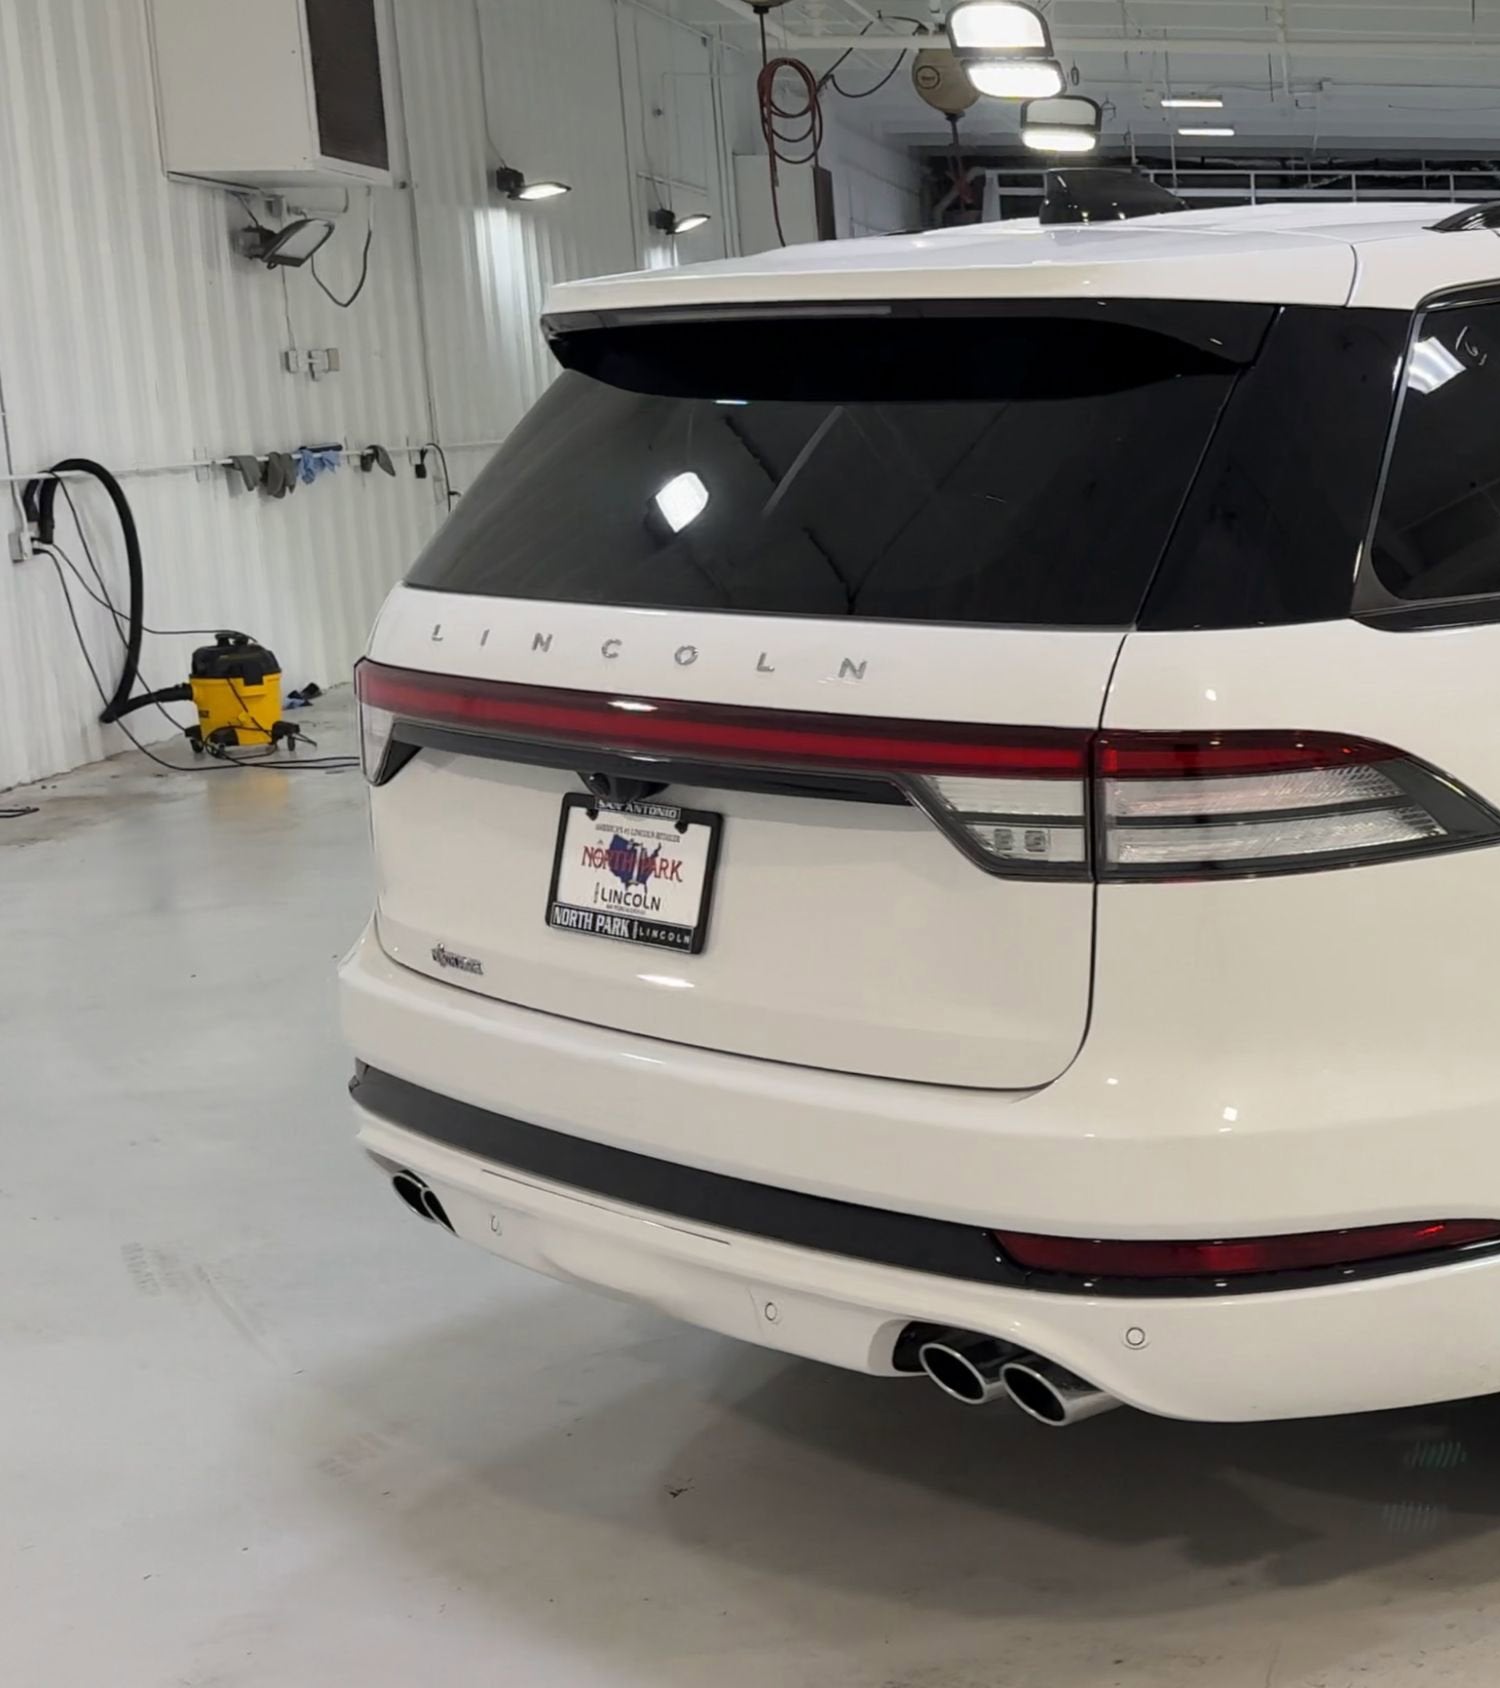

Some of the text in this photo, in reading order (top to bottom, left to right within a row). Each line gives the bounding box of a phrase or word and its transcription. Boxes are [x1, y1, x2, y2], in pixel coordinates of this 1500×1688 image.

[431, 624, 868, 680] LINCOLN
[624, 803, 678, 819] ANTONIO
[601, 888, 661, 911] LINCOLN
[553, 906, 594, 930] NORTH
[595, 914, 630, 938] PARK
[639, 927, 691, 944] LINCOLN
